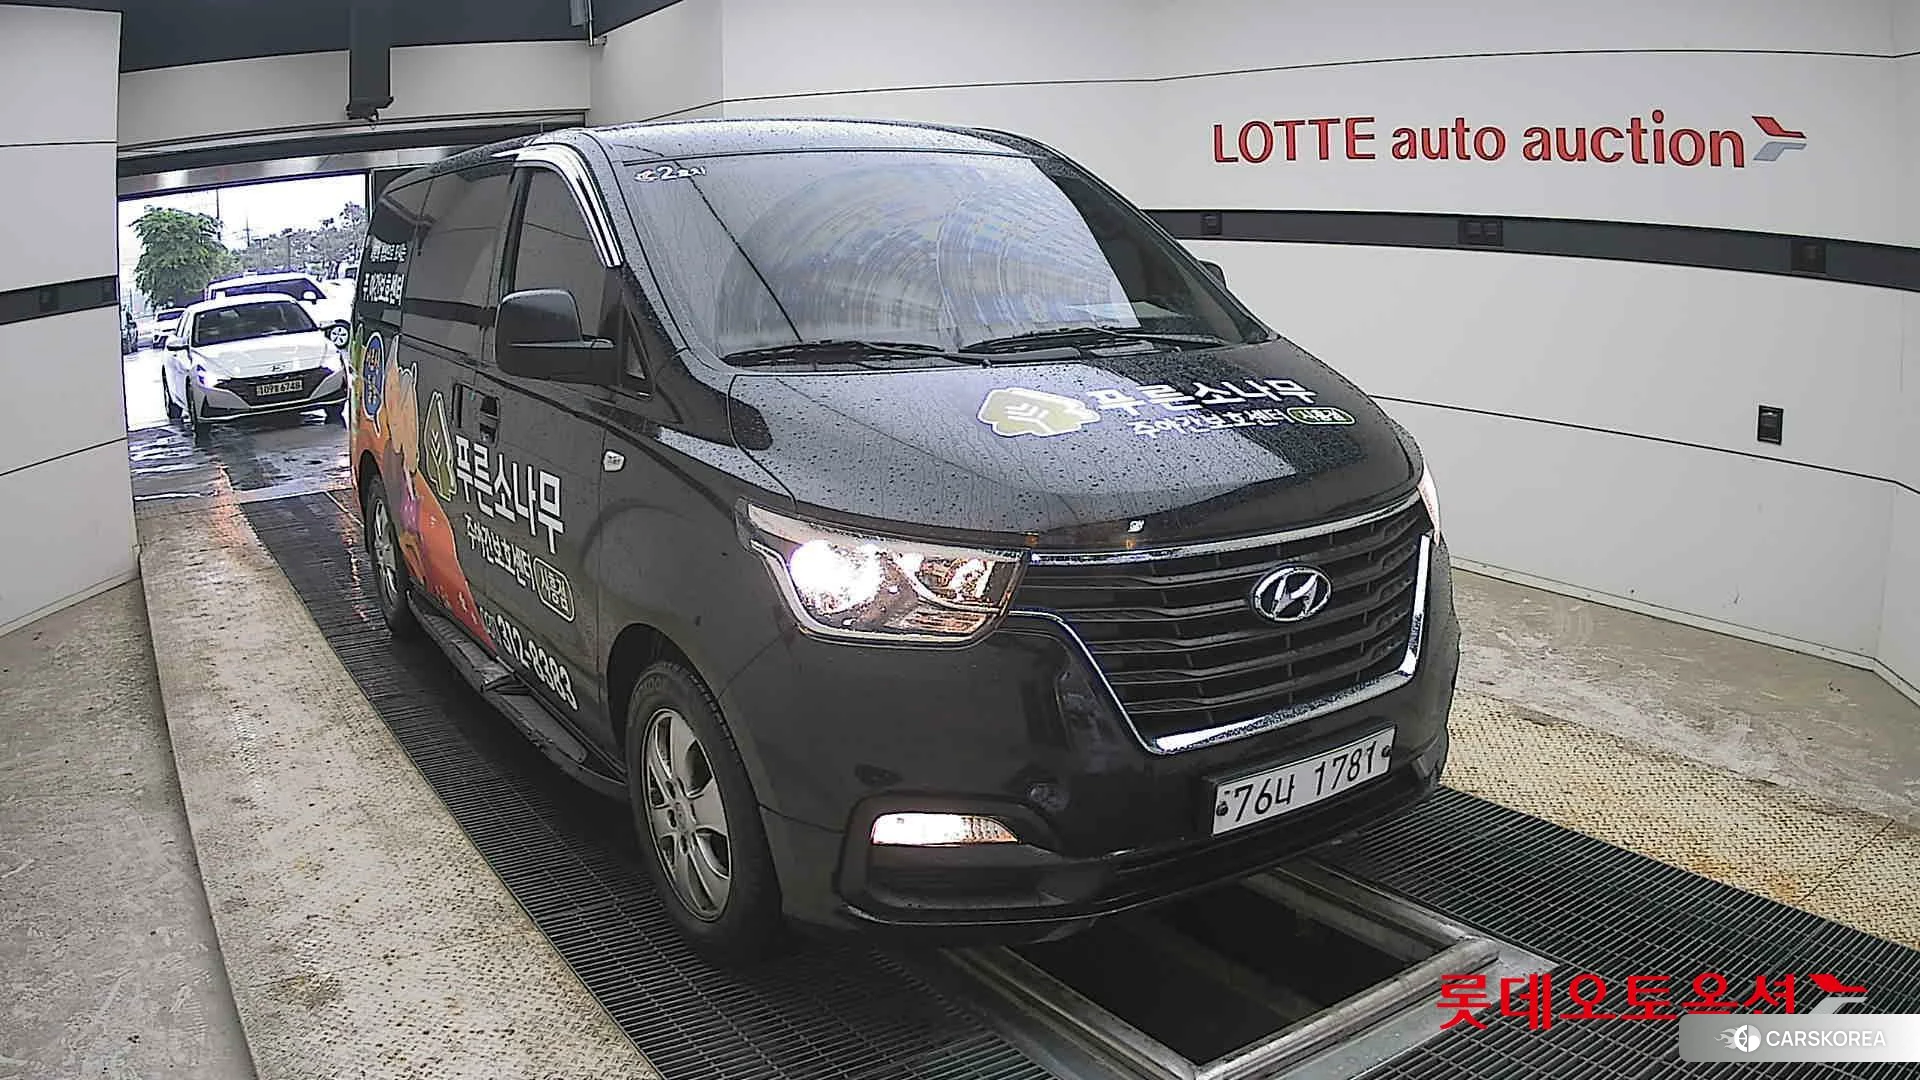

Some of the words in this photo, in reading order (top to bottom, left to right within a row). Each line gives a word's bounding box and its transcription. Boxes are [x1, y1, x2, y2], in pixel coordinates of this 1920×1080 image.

[1212, 116, 1377, 164] LOTTE
[1391, 116, 1506, 162] auto
[1522, 109, 1746, 169] auction
[1086, 378, 1319, 415] 푸른소나무
[1126, 407, 1295, 438] 주야간보호센터
[455, 434, 564, 554] 푸른소나무
[464, 512, 536, 591] 주야간보호센터
[1233, 773, 1296, 822] 76나
[1314, 740, 1378, 796] 1781
